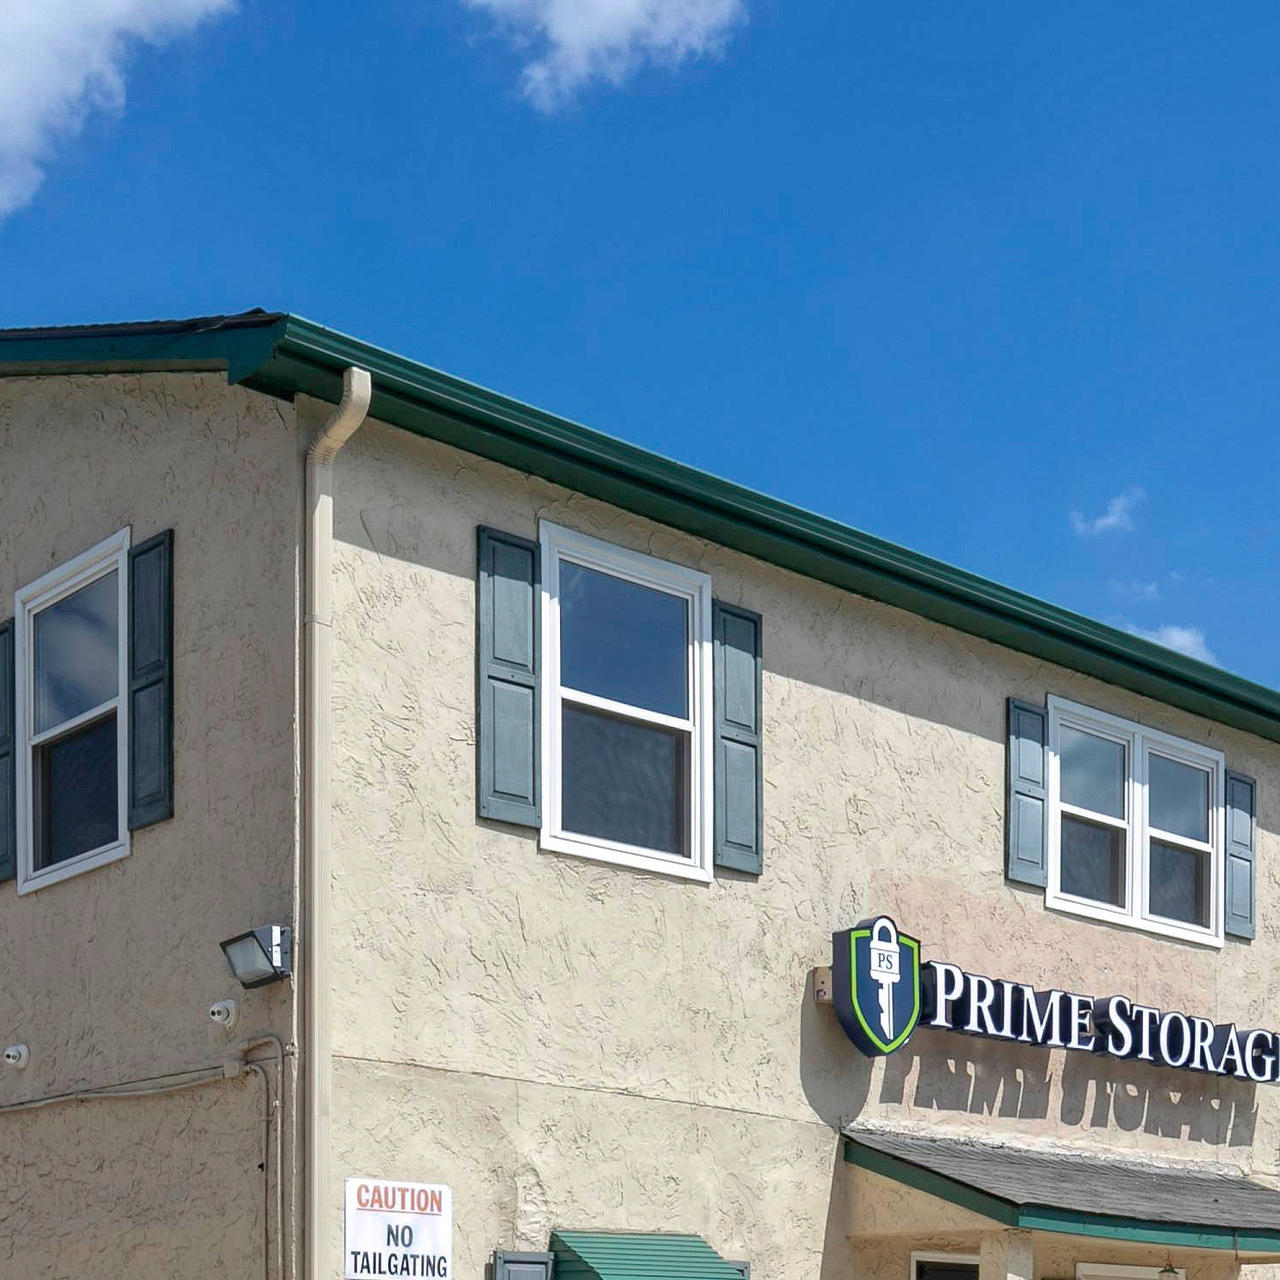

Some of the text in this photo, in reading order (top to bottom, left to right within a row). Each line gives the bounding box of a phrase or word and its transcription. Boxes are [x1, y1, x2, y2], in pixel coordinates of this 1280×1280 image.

[877, 952, 893, 970] PS
[928, 959, 1095, 1052] PRIME
[356, 1184, 443, 1213] CAUTION
[386, 1224, 413, 1247] NO
[351, 1250, 447, 1278] TAILGATING
